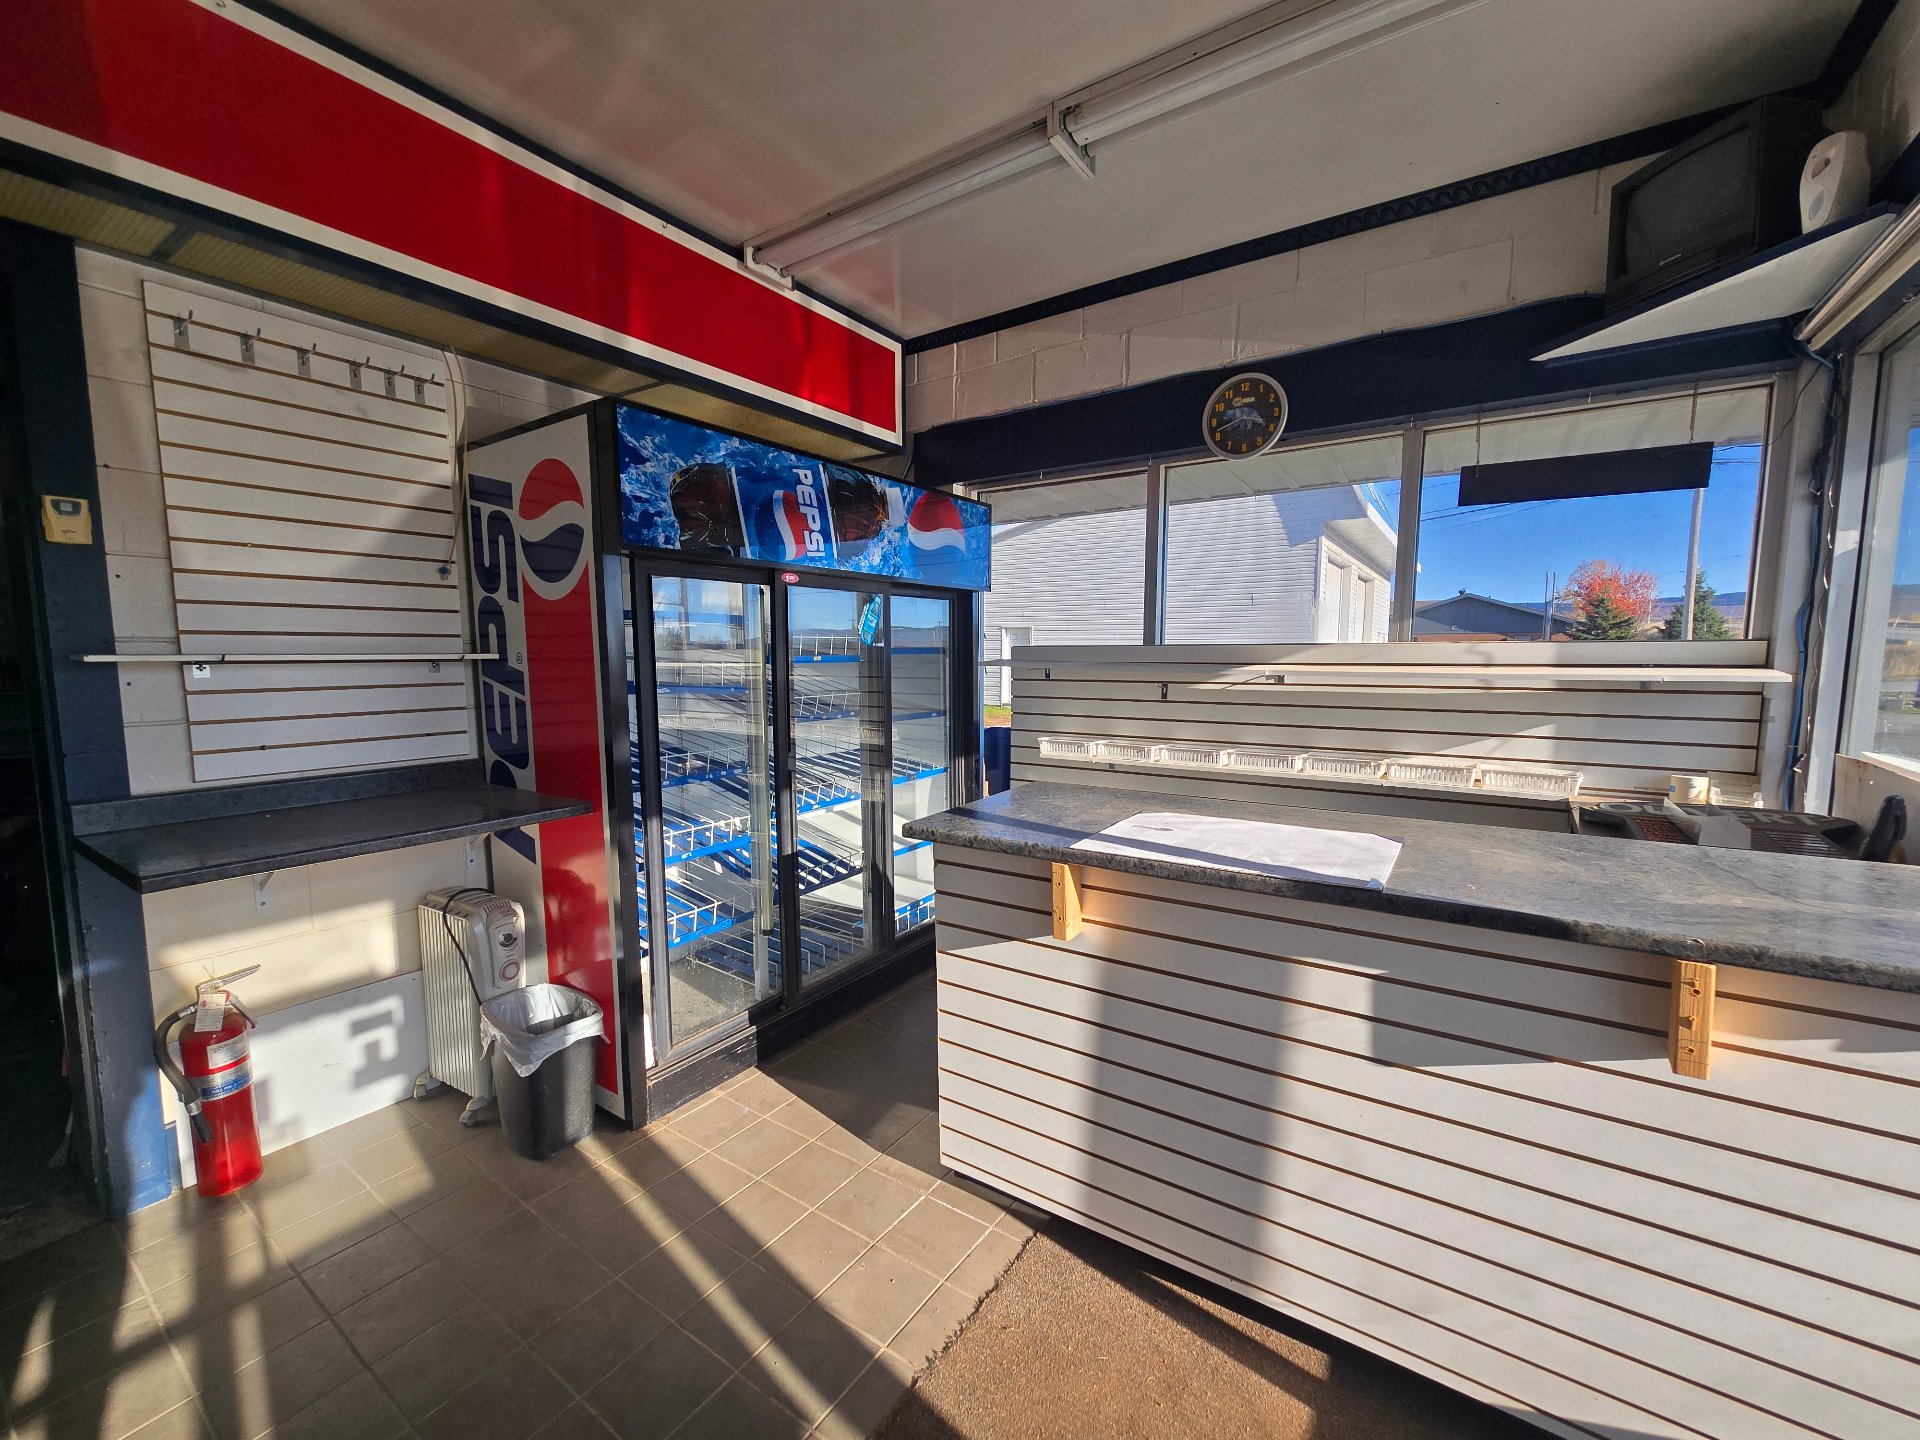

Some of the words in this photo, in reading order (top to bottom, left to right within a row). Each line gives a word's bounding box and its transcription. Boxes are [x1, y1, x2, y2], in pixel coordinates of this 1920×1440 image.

[1240, 382, 1250, 392] 12
[1259, 385, 1264, 393] 1
[1225, 390, 1233, 399] 11
[1269, 393, 1275, 402] 2
[1215, 403, 1225, 412] 10
[1273, 407, 1279, 416] 3
[1211, 418, 1217, 427] 9
[1268, 423, 1274, 432] 4
[1215, 432, 1221, 441] 8
[1227, 441, 1232, 450] 7
[1256, 437, 1262, 446] 5
[1241, 443, 1247, 452] 6
[792, 468, 825, 557] PEPSI
